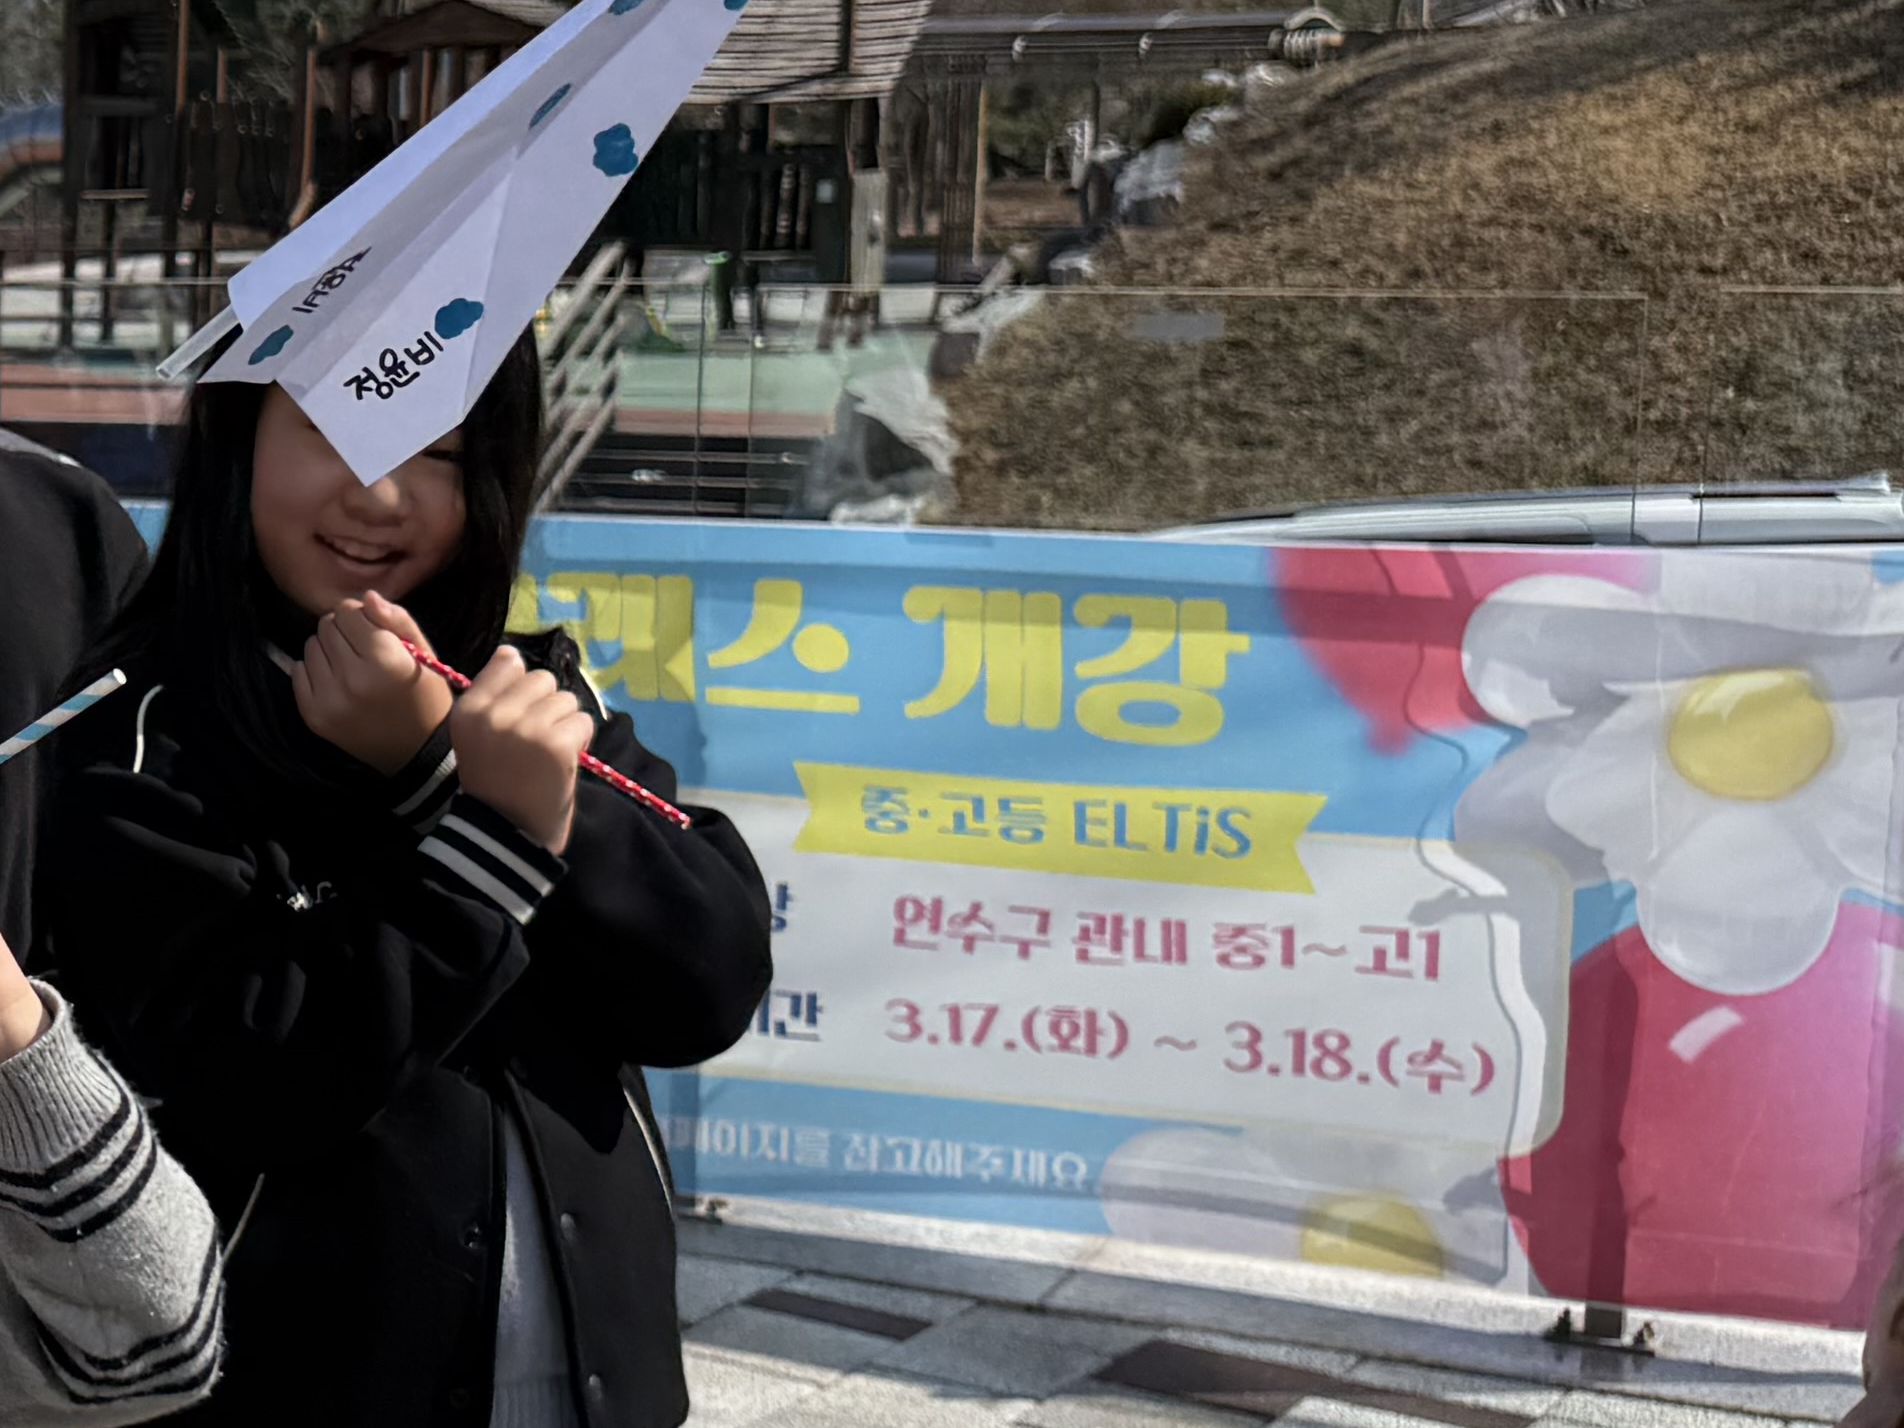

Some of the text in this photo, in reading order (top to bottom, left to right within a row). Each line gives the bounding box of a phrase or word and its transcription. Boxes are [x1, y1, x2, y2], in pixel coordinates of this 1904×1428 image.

[343, 331, 444, 400] 정윤비
[505, 571, 1250, 746] 래스 개강
[861, 774, 1048, 845] 중·고등
[892, 894, 1441, 982] 연수구 관내 중1~고1
[884, 998, 1130, 1060] 3.17.(화)
[1223, 1021, 1496, 1097] 3.18.(수)
[660, 1117, 830, 1168] 페이지를
